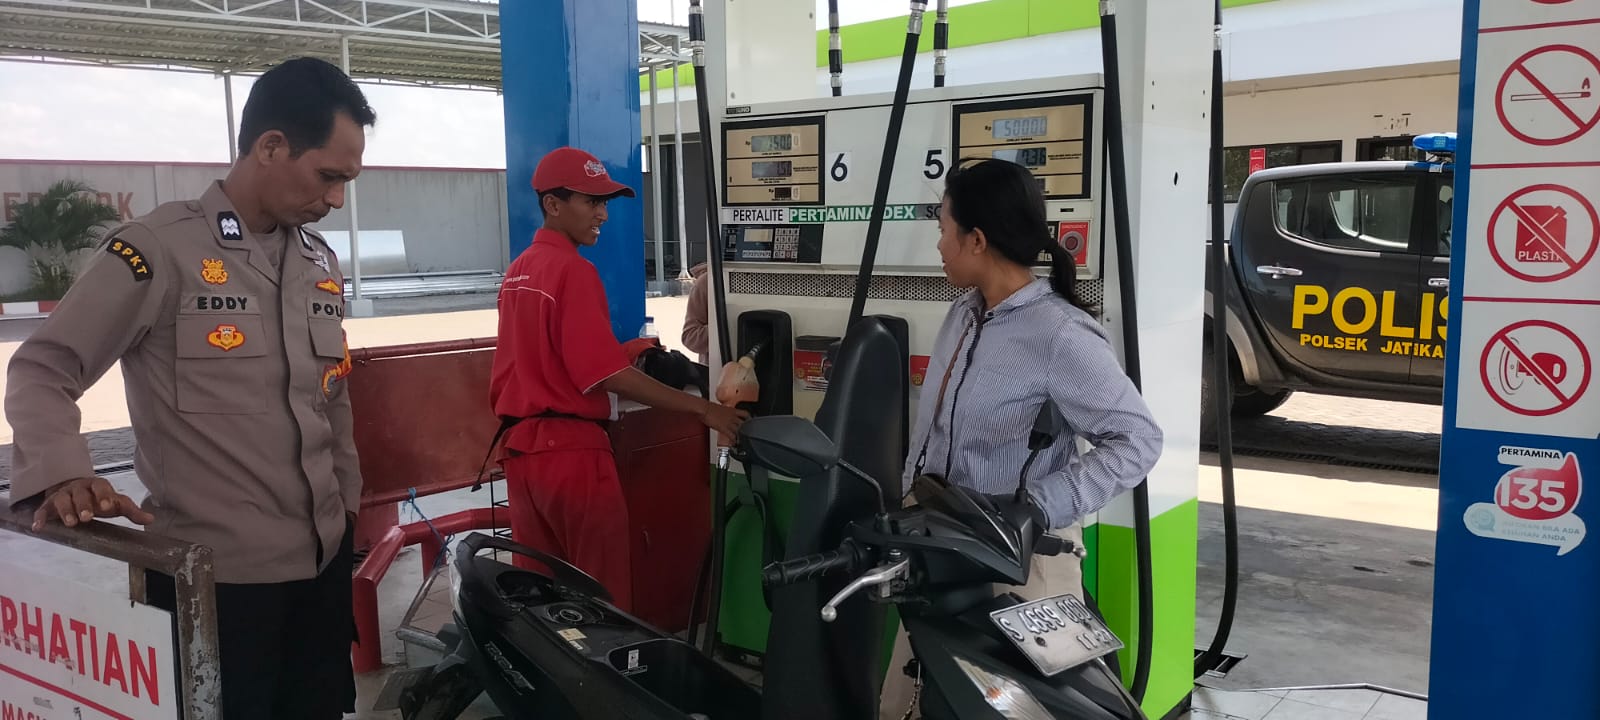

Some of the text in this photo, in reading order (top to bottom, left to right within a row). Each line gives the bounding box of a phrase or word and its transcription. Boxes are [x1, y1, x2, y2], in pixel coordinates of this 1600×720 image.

[830, 153, 848, 181] 6
[923, 149, 944, 180] 5
[733, 209, 783, 222] PERTALITE
[112, 241, 148, 274] SPKT
[197, 296, 248, 310] EDDY
[1292, 284, 1449, 342] POLI
[1300, 333, 1444, 358] POLSEK JATIKA
[1501, 447, 1560, 459] PERTAMINA
[1500, 475, 1565, 513] 135
[1000, 617, 1025, 642] S
[1018, 605, 1065, 634] 4699
[0, 595, 160, 707] RHATIAN
